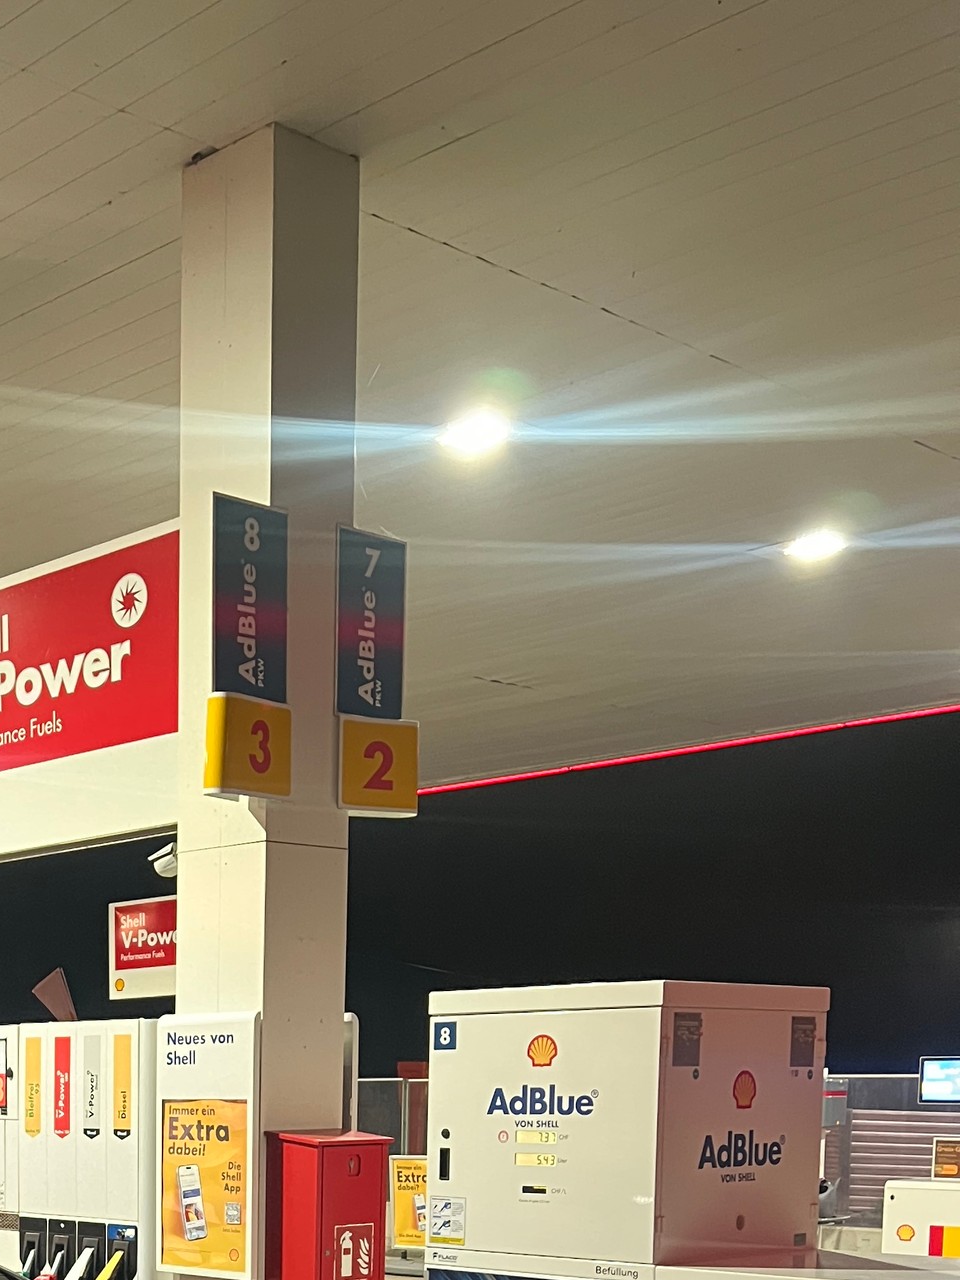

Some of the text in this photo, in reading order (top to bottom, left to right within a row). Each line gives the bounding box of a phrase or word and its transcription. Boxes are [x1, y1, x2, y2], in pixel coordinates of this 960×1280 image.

[243, 517, 261, 551] 8
[364, 547, 381, 578] 7
[257, 658, 265, 687] PKW
[30, 711, 63, 738] Fuels
[248, 719, 272, 774] 3
[362, 740, 395, 791] 2
[120, 912, 145, 929] Shell
[121, 929, 178, 949] V-Pow
[120, 949, 165, 961] Performance Fuels
[167, 1032, 234, 1046] Neues von
[439, 1026, 451, 1045] 8
[166, 1050, 196, 1066] Shell
[169, 1105, 216, 1116] Immer ein
[168, 1116, 230, 1142] Extra
[515, 1120, 559, 1128] VON SHELL
[168, 1142, 206, 1156] dabei!
[228, 1161, 241, 1171] Die
[221, 1172, 241, 1181] Shell
[721, 1172, 756, 1183] VON SHELL
[224, 1183, 241, 1195] App
[595, 1265, 639, 1279] Befüllung
